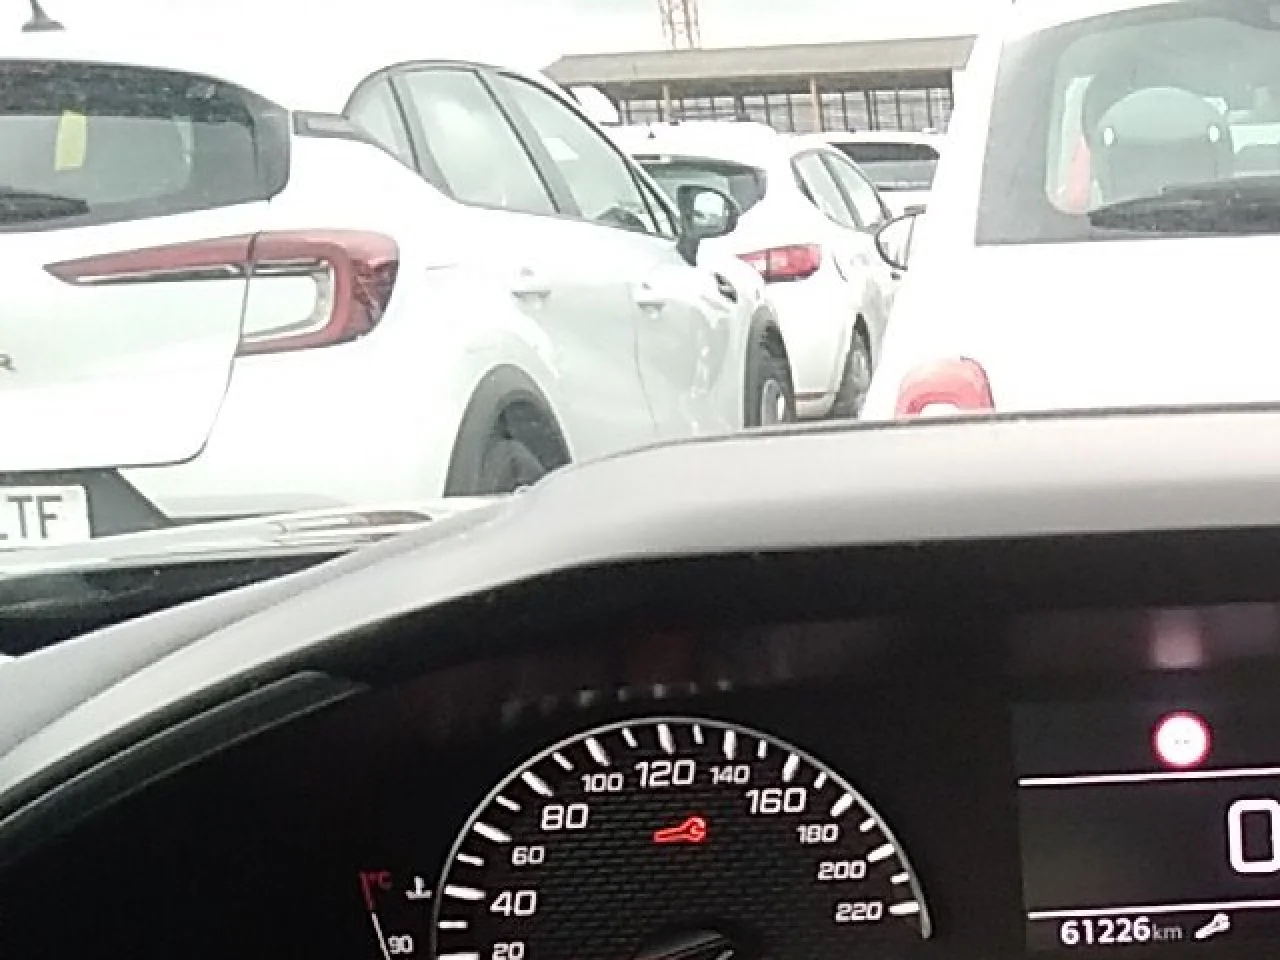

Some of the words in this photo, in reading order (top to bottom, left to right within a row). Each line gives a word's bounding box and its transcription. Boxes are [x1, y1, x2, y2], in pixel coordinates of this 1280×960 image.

[0, 495, 63, 540] TF
[581, 771, 623, 793] 100
[635, 759, 696, 786] 120
[709, 765, 751, 785] 140
[745, 787, 807, 815] 160
[541, 803, 589, 831] 80
[797, 823, 839, 844] 180
[511, 845, 545, 866] 60
[818, 859, 867, 881] 200
[489, 889, 537, 917] 40
[835, 901, 883, 922] 220
[1060, 916, 1150, 945] 61226
[1151, 923, 1183, 941] km
[387, 935, 414, 955] 90
[491, 941, 525, 960] 20
